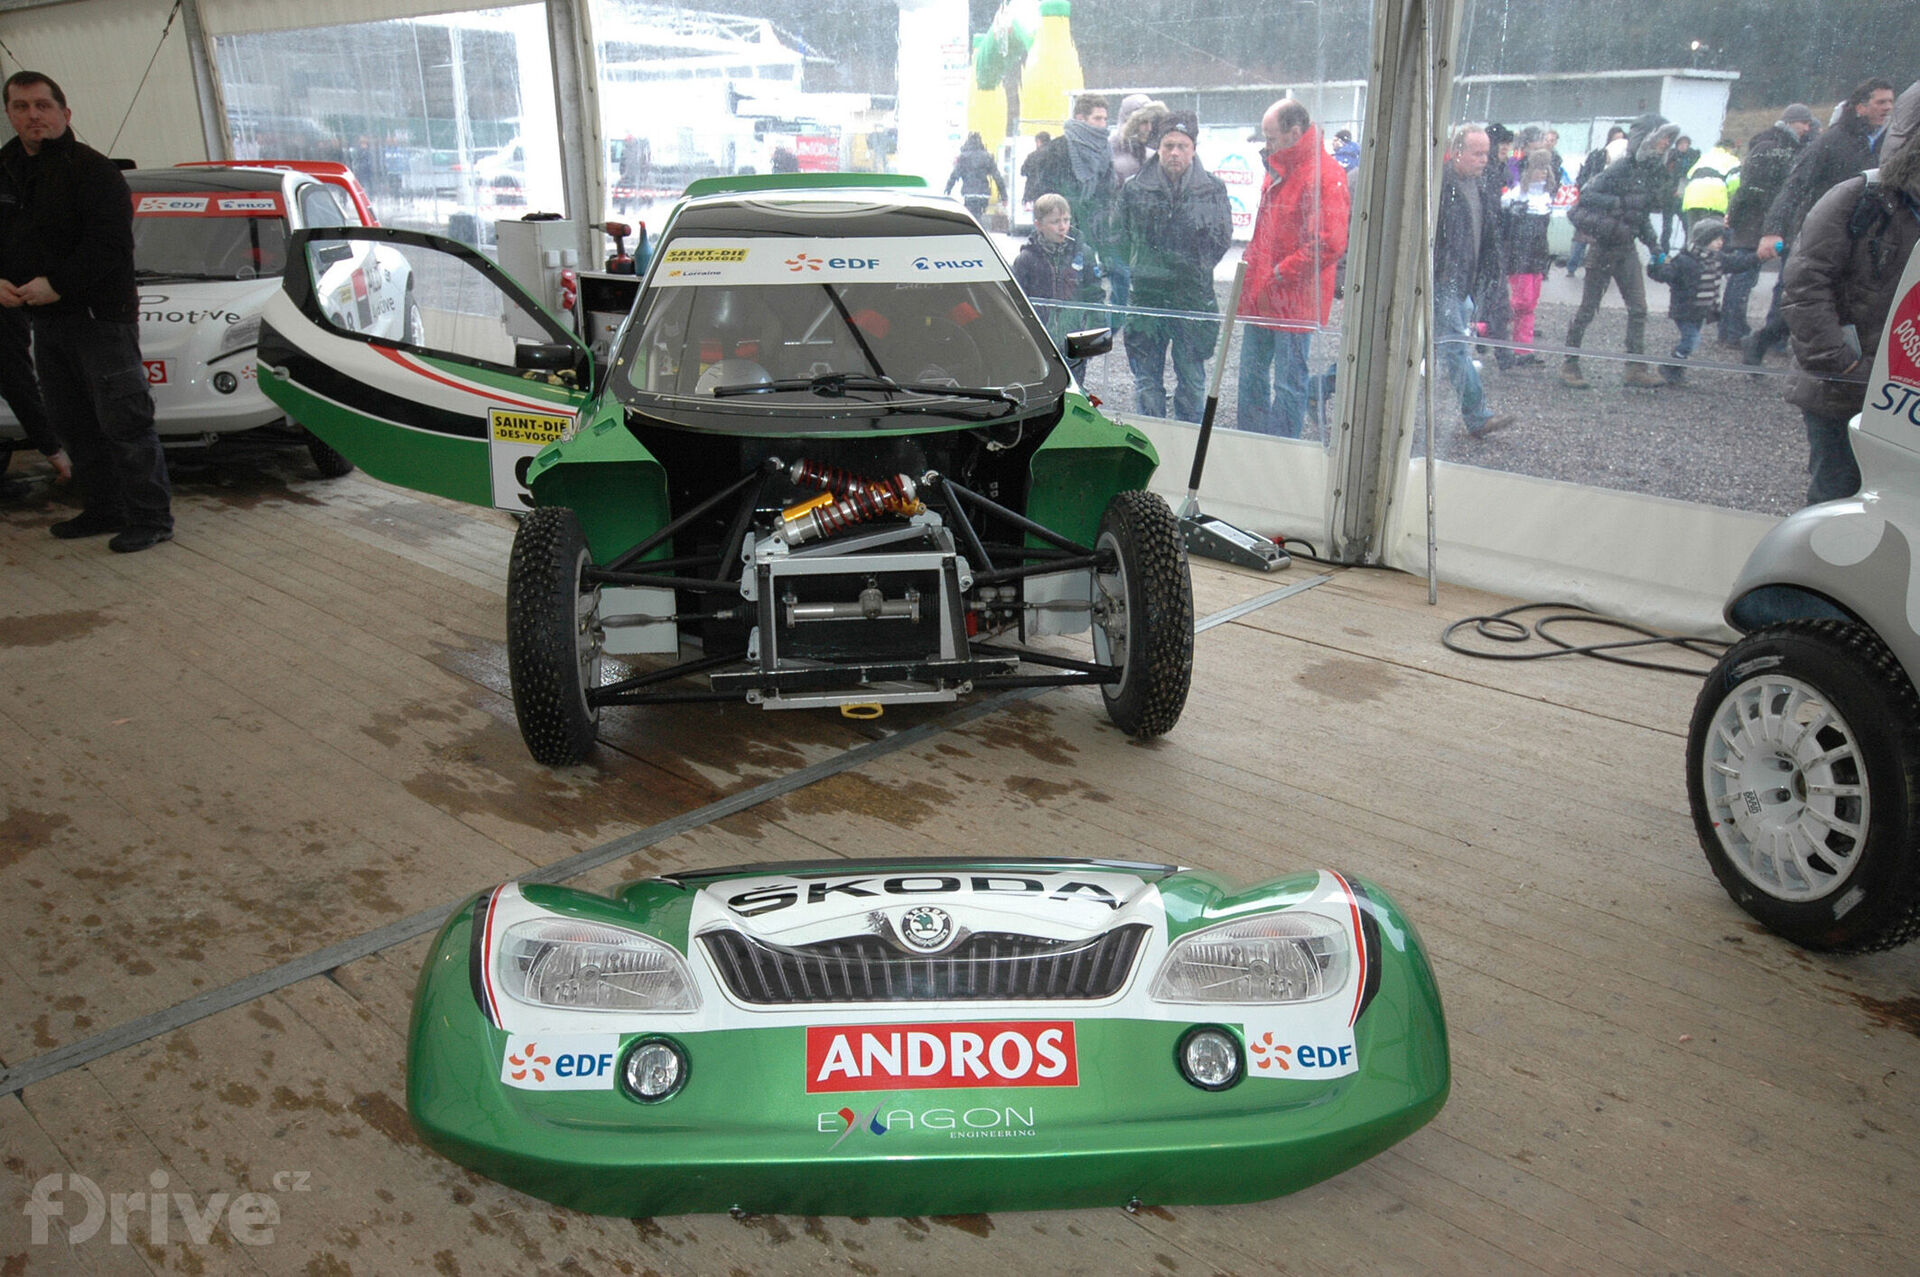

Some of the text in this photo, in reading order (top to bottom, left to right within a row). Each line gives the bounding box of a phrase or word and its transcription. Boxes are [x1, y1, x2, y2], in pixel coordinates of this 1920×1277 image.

[670, 249, 746, 257] SAINT-DIÉ
[933, 259, 985, 270] PILOT
[495, 416, 567, 433] SAINT-DIÉ
[816, 1028, 1068, 1082] ANDROS
[949, 1130, 1036, 1139] ENGINEERING
